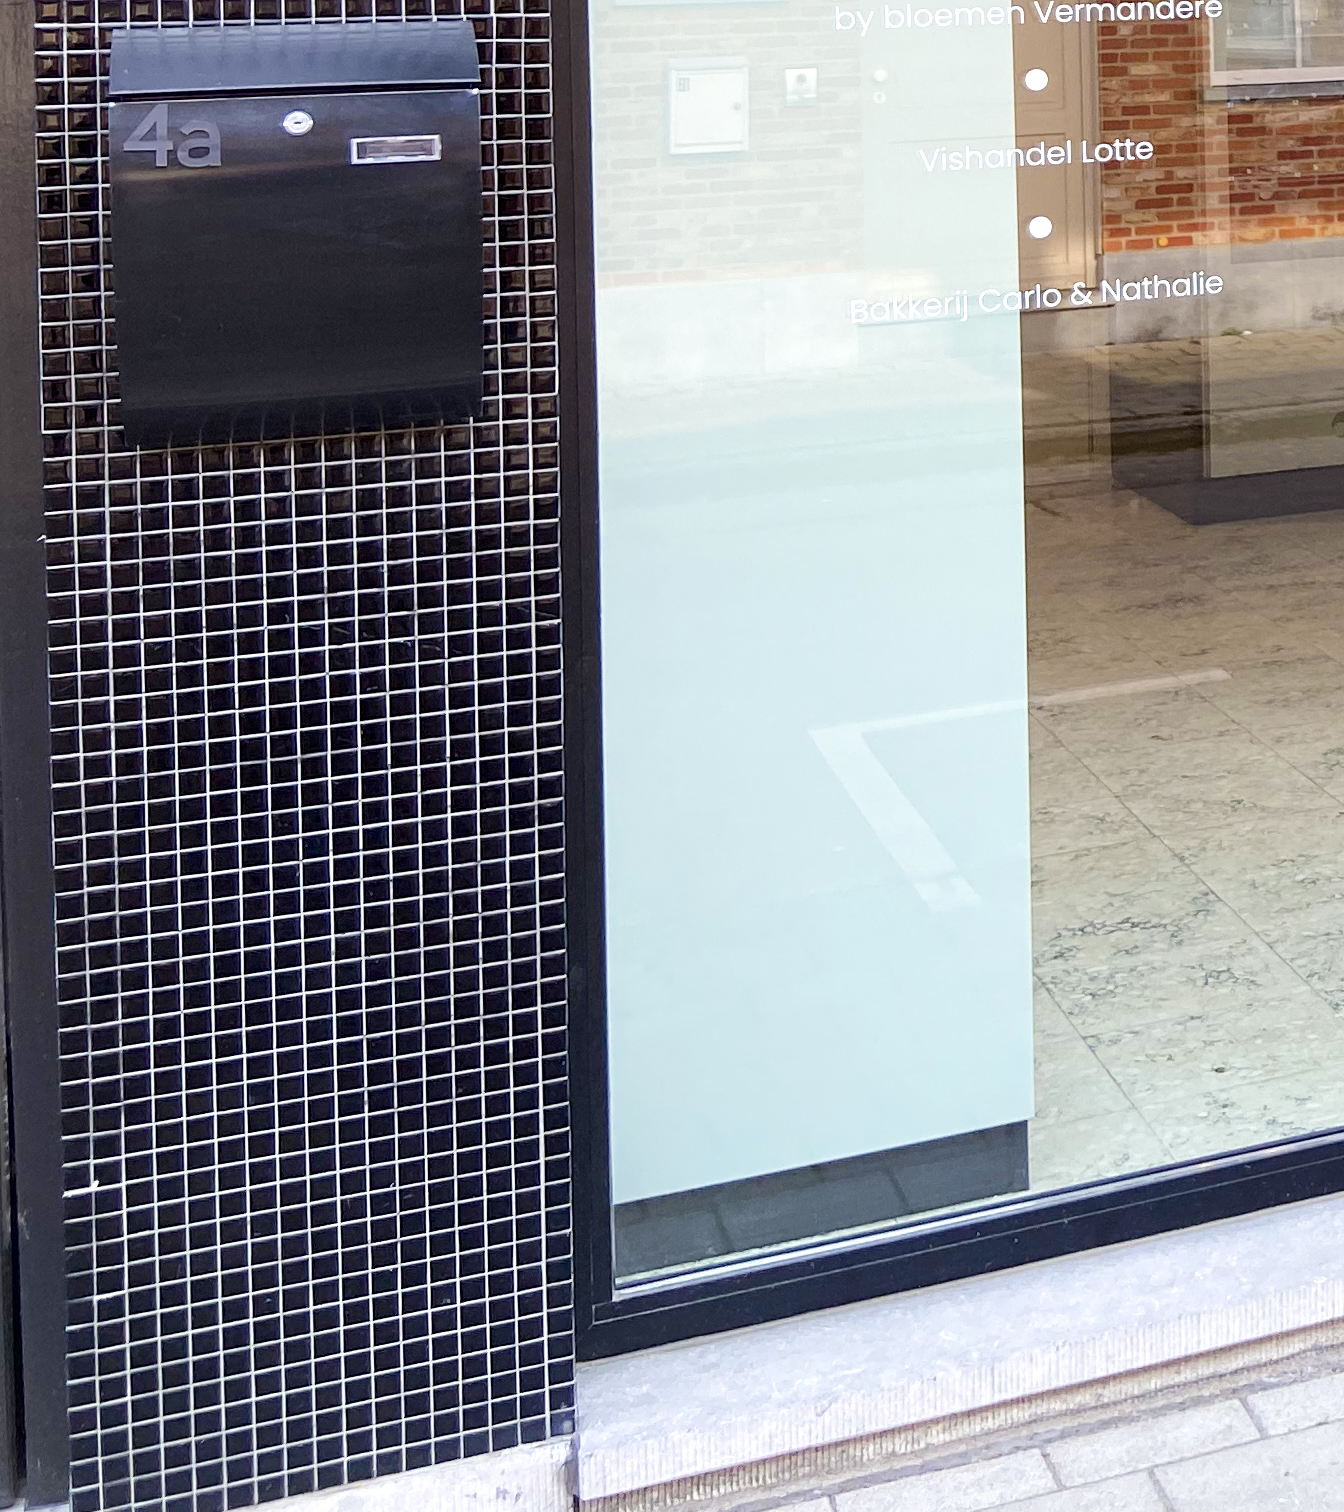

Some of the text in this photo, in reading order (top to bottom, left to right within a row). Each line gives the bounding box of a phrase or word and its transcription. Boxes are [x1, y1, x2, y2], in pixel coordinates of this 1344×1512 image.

[834, 5, 876, 37] by
[884, 3, 1025, 31] bloemen
[122, 102, 223, 169] 4a
[919, 137, 1154, 172] Vishandel Lotte
[849, 271, 1224, 324] Bakkerij Carlo & Nathalie
